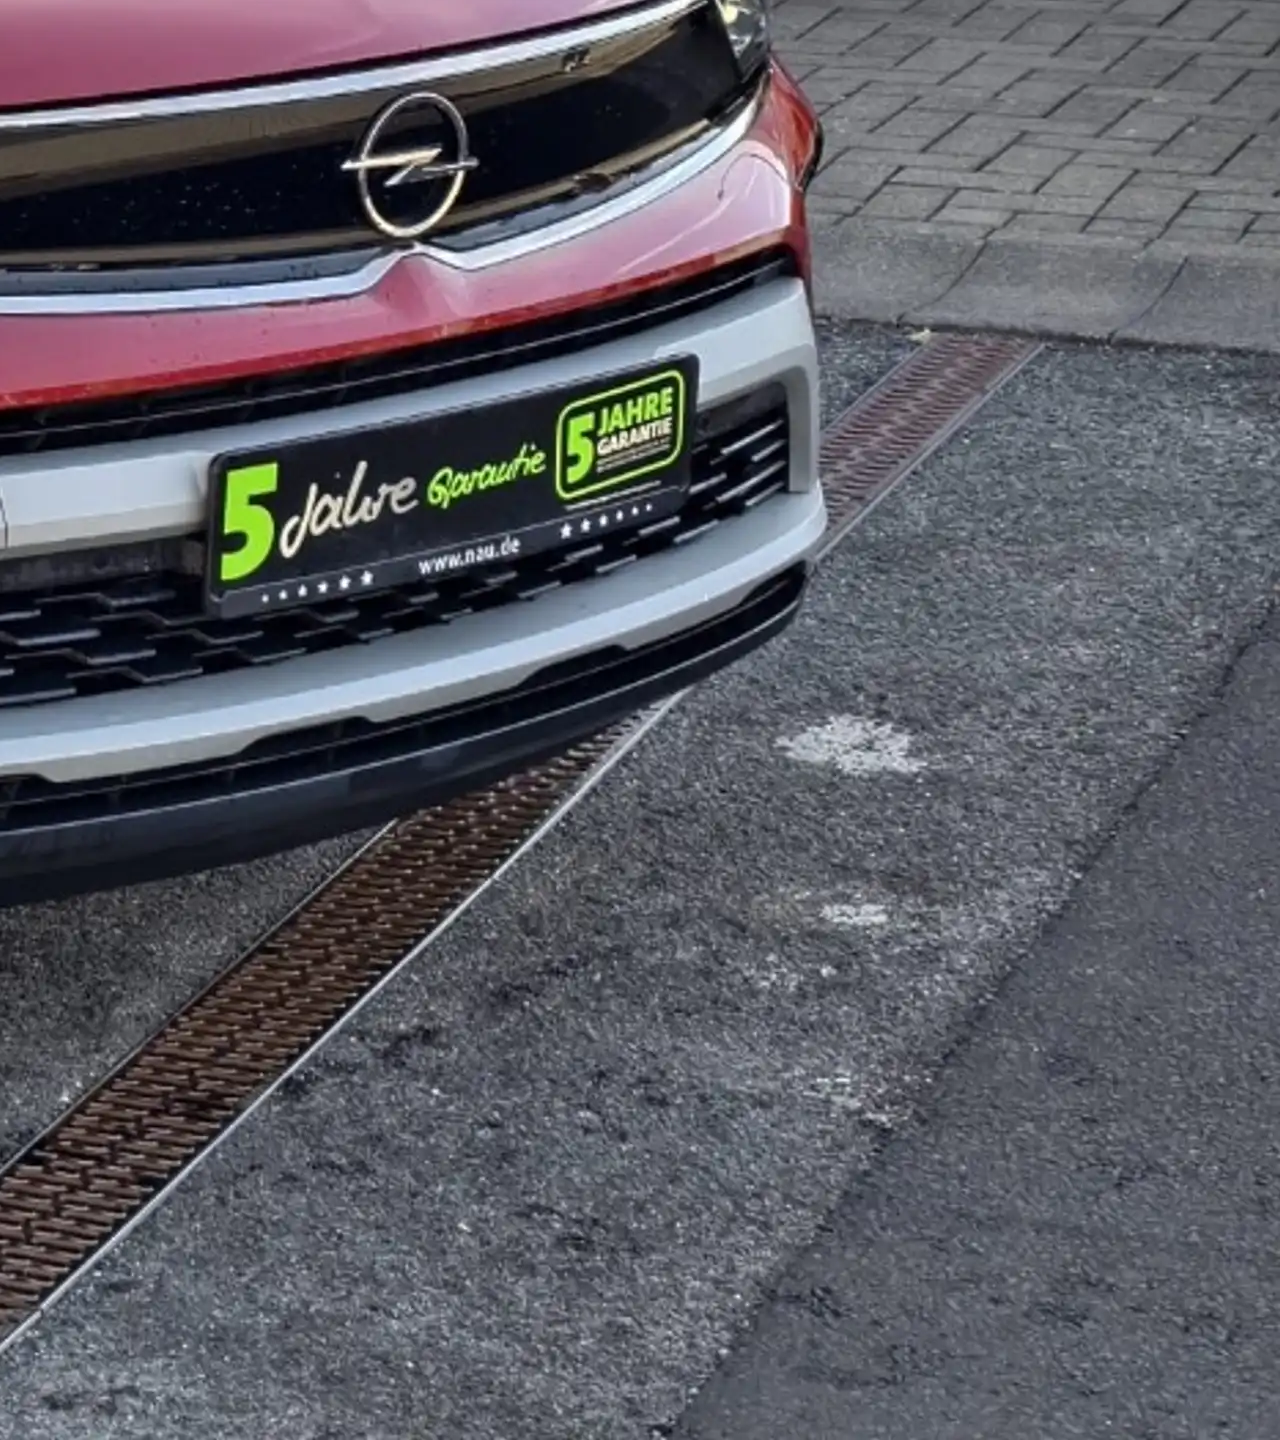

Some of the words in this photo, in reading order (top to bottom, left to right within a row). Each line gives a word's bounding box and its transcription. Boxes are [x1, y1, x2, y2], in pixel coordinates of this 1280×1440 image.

[566, 411, 595, 484] 5
[597, 386, 673, 437] JAHRE
[597, 416, 673, 456] GARANTIE
[220, 462, 279, 581] 5
[279, 460, 418, 558] Jahre
[418, 534, 521, 575] www.nau.de
